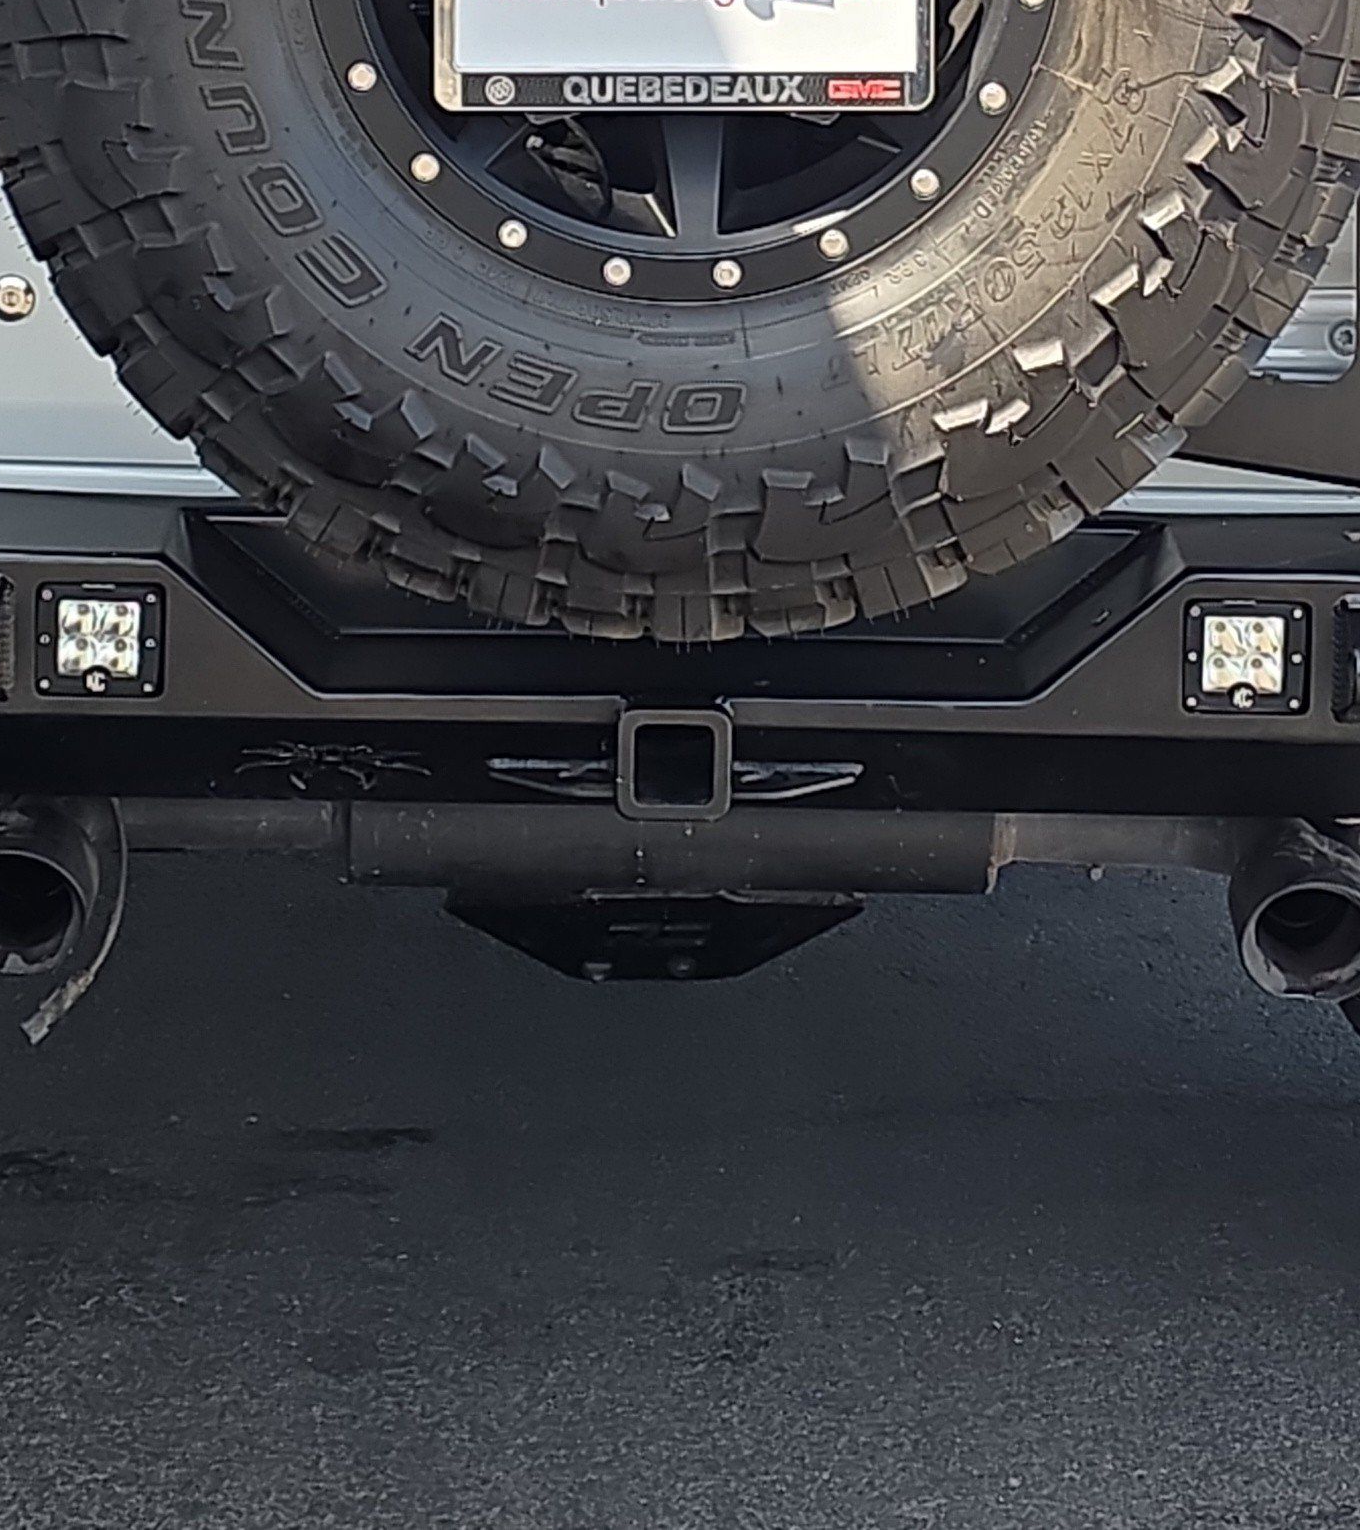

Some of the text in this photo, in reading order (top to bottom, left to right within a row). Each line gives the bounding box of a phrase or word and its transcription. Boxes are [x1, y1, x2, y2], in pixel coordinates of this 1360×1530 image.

[563, 75, 902, 105] QUEBEDEAUX GMC
[404, 312, 747, 434] OPEN
